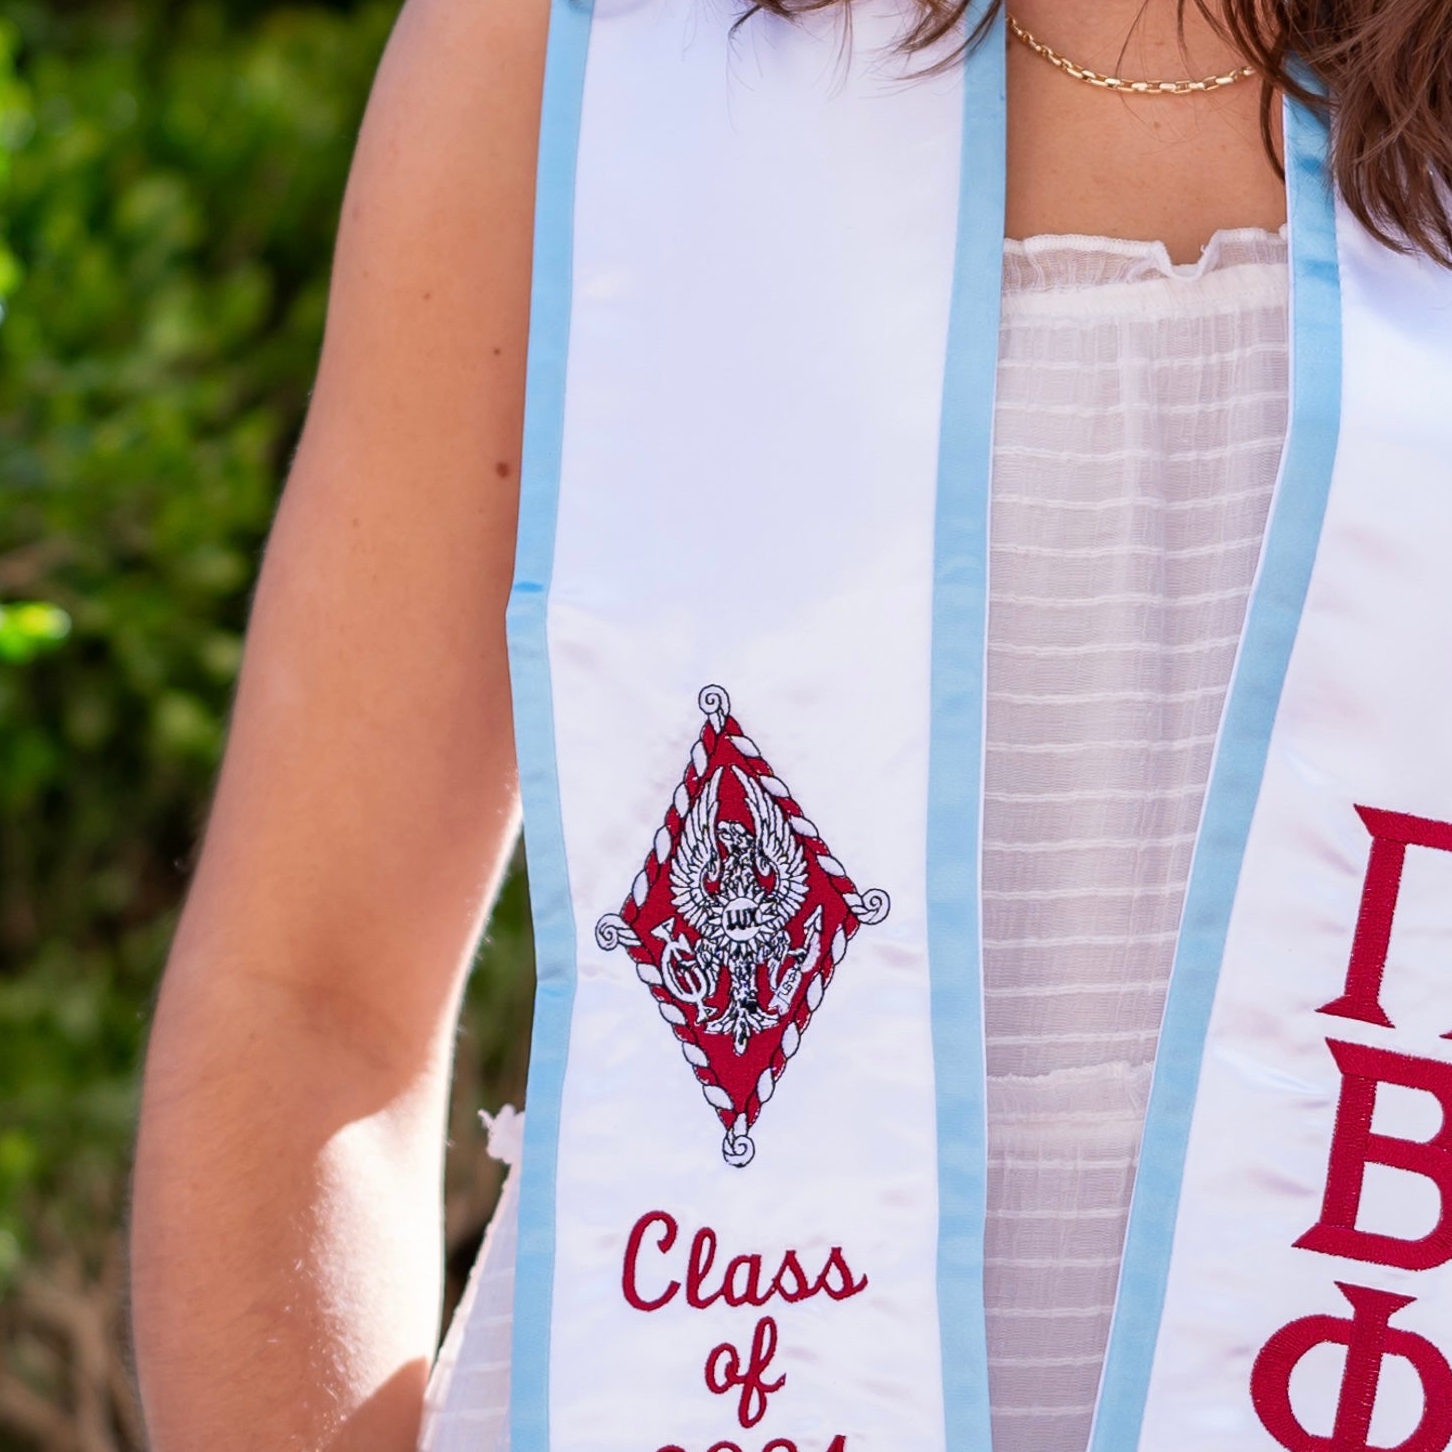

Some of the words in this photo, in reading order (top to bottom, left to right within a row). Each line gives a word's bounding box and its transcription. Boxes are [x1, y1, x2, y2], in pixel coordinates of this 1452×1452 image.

[726, 908, 762, 930] LUX
[621, 1210, 868, 1313] Class
[704, 1316, 786, 1429] of
